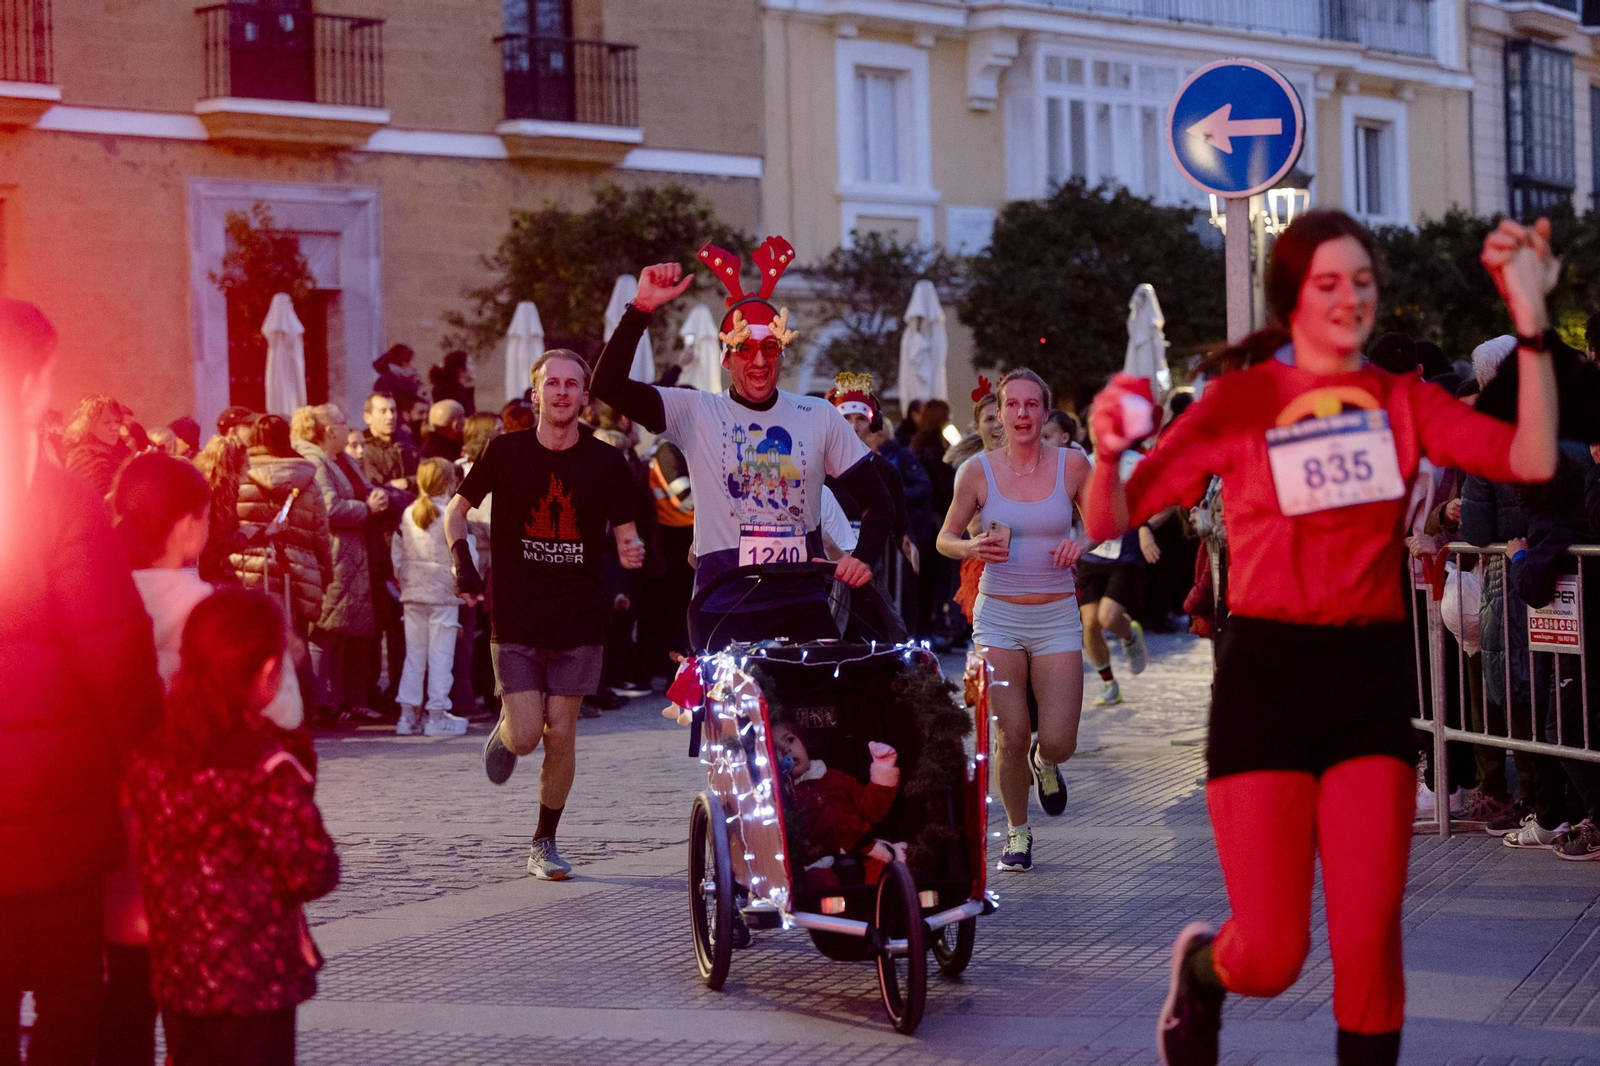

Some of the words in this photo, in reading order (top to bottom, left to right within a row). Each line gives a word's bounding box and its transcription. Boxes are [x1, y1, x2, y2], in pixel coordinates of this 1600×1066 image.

[797, 441, 807, 514] GADITANA
[1304, 449, 1372, 488] 835
[521, 539, 583, 553] TOUGH
[748, 546, 800, 566] 1240
[524, 551, 583, 563] MUDDER
